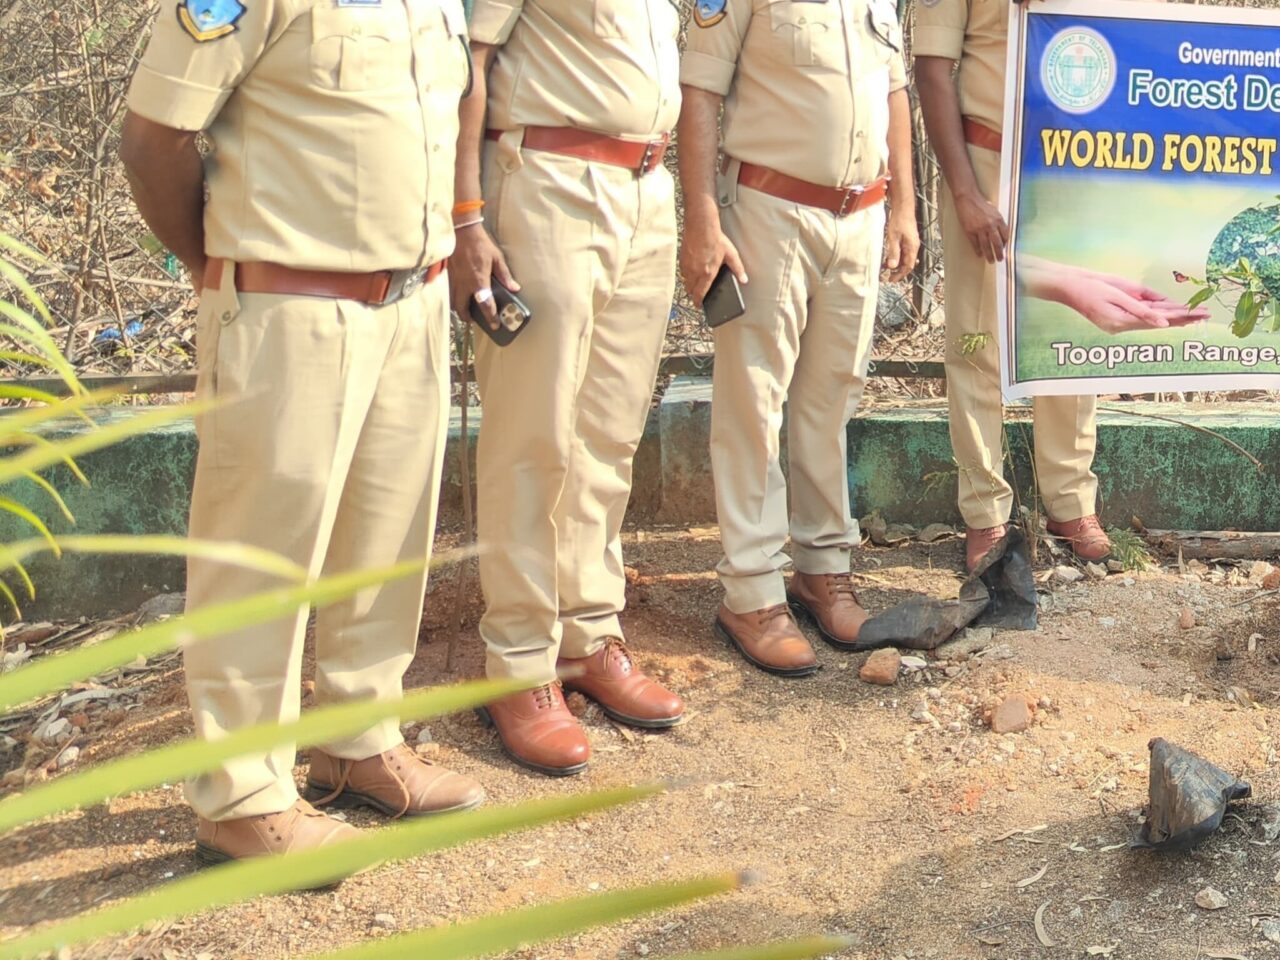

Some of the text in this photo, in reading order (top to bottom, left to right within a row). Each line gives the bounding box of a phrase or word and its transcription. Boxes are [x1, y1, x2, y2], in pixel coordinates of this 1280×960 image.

[1178, 41, 1280, 69] Government
[1128, 68, 1237, 109] Forest
[1041, 129, 1154, 170] WORLD
[1162, 134, 1276, 174] FOREST
[1052, 342, 1173, 368] Toopran
